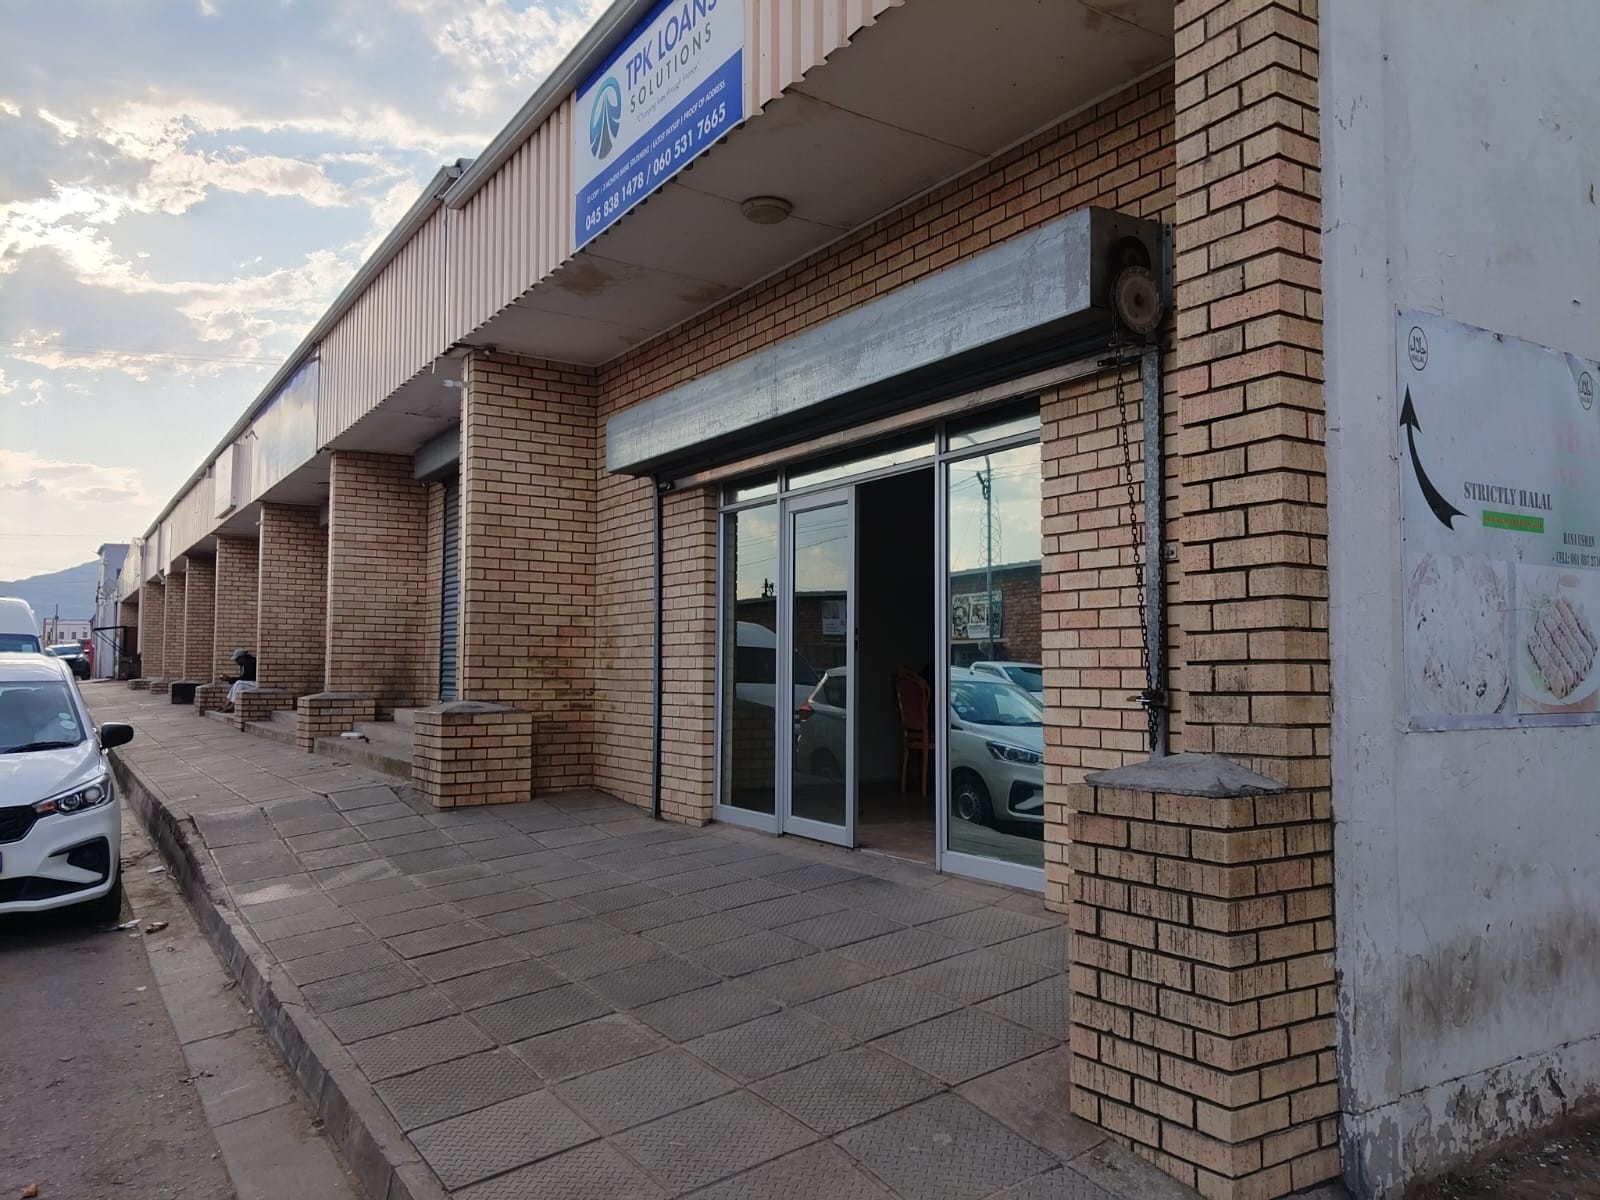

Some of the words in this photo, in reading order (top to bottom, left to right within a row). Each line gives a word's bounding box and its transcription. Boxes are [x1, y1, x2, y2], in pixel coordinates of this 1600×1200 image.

[626, 40, 653, 91] TPK
[630, 22, 712, 113] SOLUTIONS
[684, 102, 698, 120] PROOF
[698, 97, 705, 107] OF
[705, 80, 726, 102] ADDRESS
[585, 206, 602, 230] 045
[603, 191, 619, 217] 838
[622, 171, 644, 202] 1478
[646, 163, 652, 185] /
[653, 148, 671, 176] 060
[674, 129, 692, 159] 531
[697, 101, 726, 140] 7665
[1463, 481, 1516, 506] STRICTLY
[1519, 489, 1553, 511] HALAL
[1556, 551, 1569, 565] CELL:
